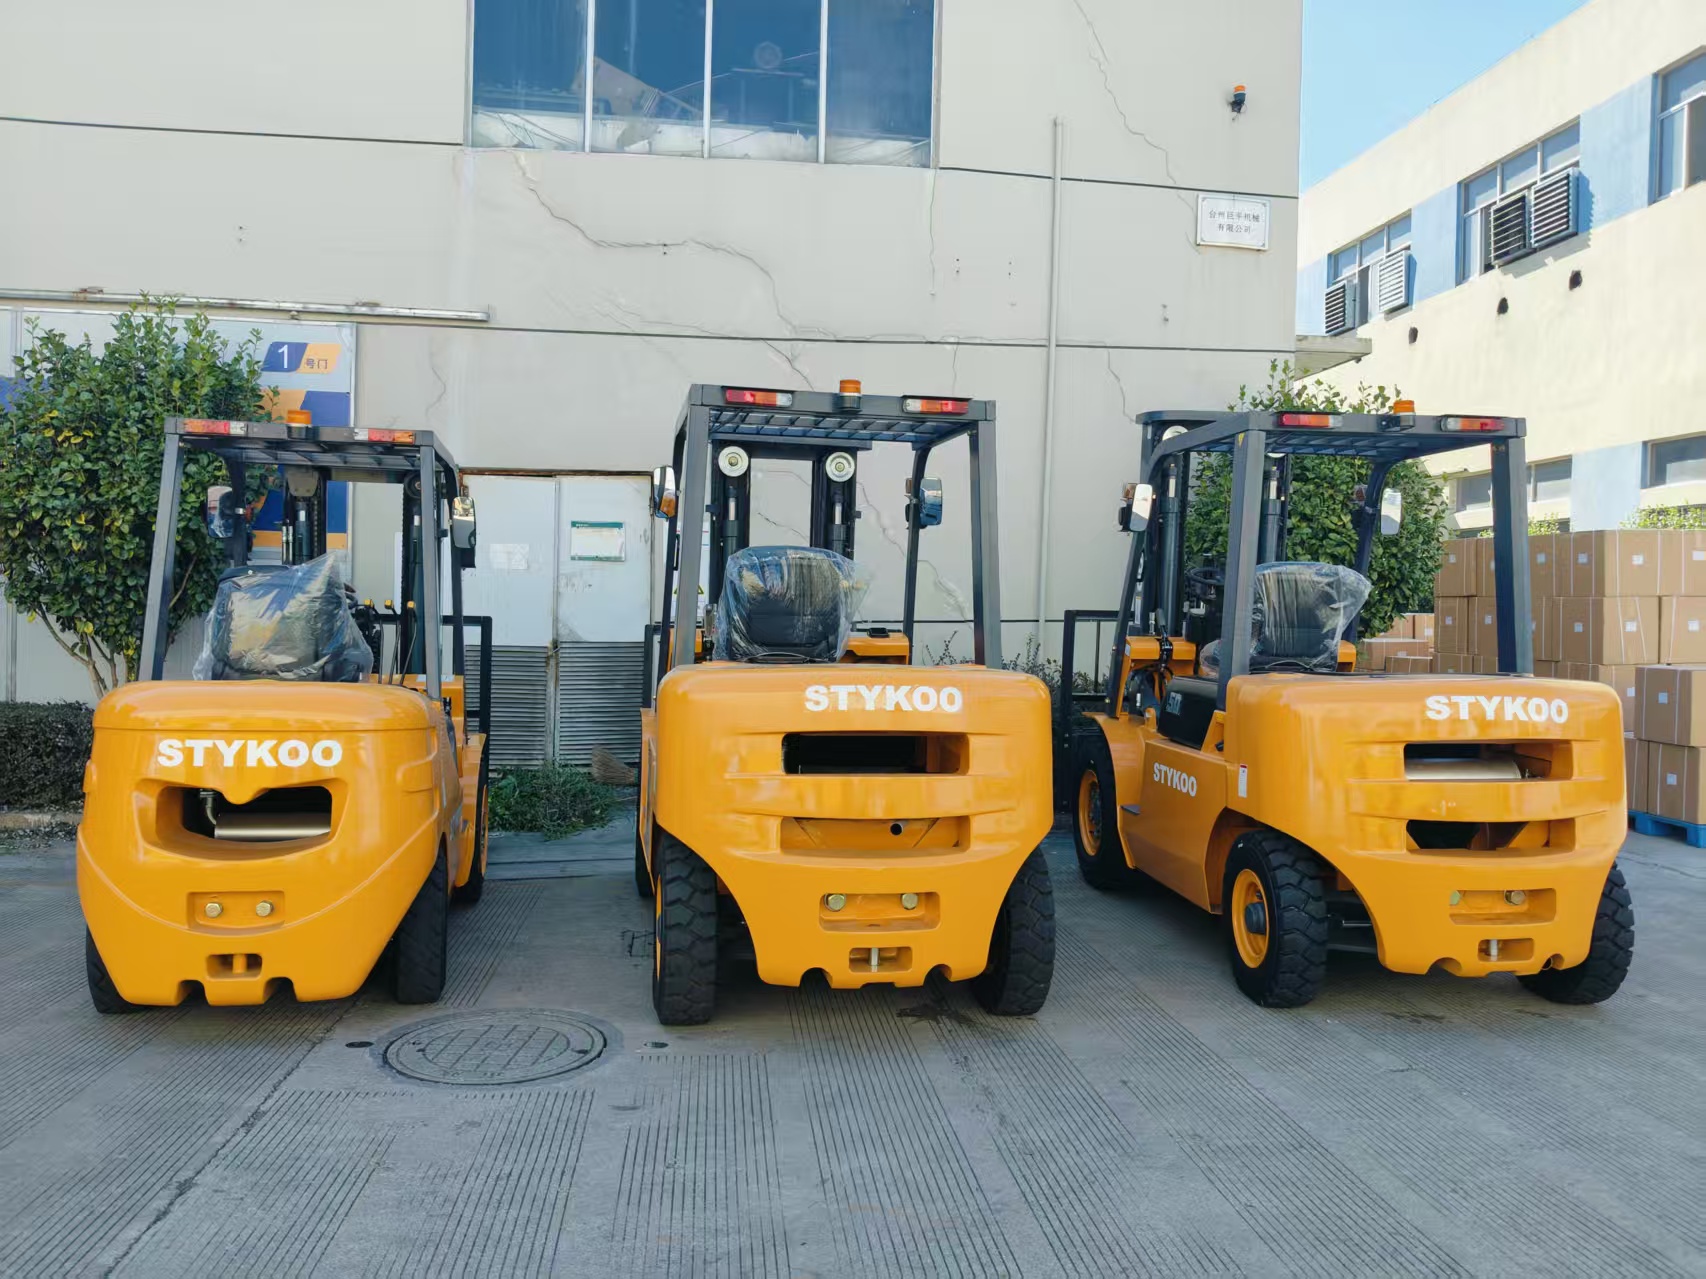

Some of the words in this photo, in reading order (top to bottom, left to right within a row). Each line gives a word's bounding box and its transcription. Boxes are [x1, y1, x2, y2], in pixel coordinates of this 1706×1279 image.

[1218, 223, 1251, 234] 有限公司
[278, 344, 288, 369] 1
[305, 358, 328, 370] 号门
[804, 684, 963, 714] STYKOO
[1425, 695, 1569, 724] STYKOO
[157, 739, 343, 769] STYKOO
[1153, 762, 1198, 797] STYKOO
